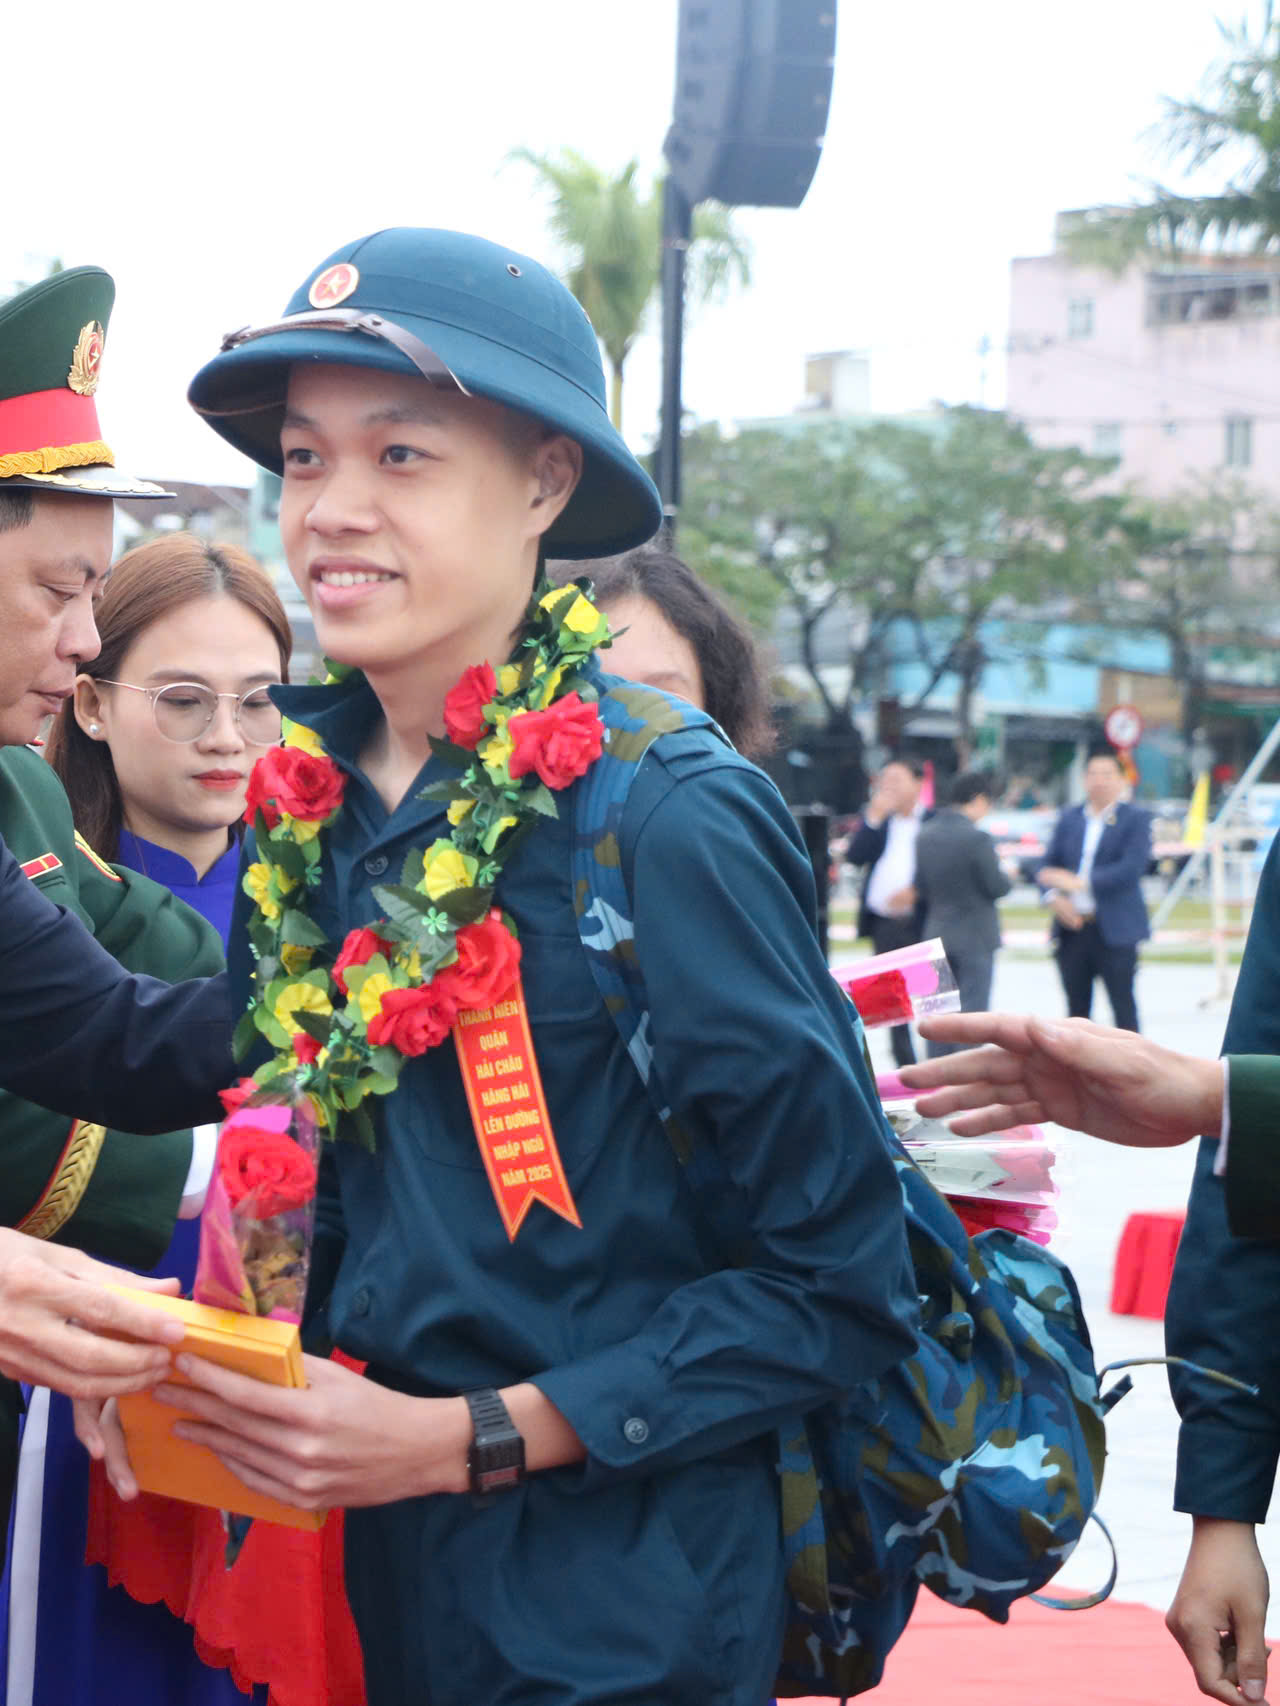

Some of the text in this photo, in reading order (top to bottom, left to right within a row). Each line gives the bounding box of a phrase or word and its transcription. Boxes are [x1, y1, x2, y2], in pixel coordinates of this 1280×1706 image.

[480, 1030, 508, 1050] QUẬN
[475, 1055, 522, 1079] HẢI CHÂU
[483, 1116, 504, 1134] LÊN
[493, 1141, 520, 1160] NHẬP
[501, 1164, 552, 1186] NĂM 2025
